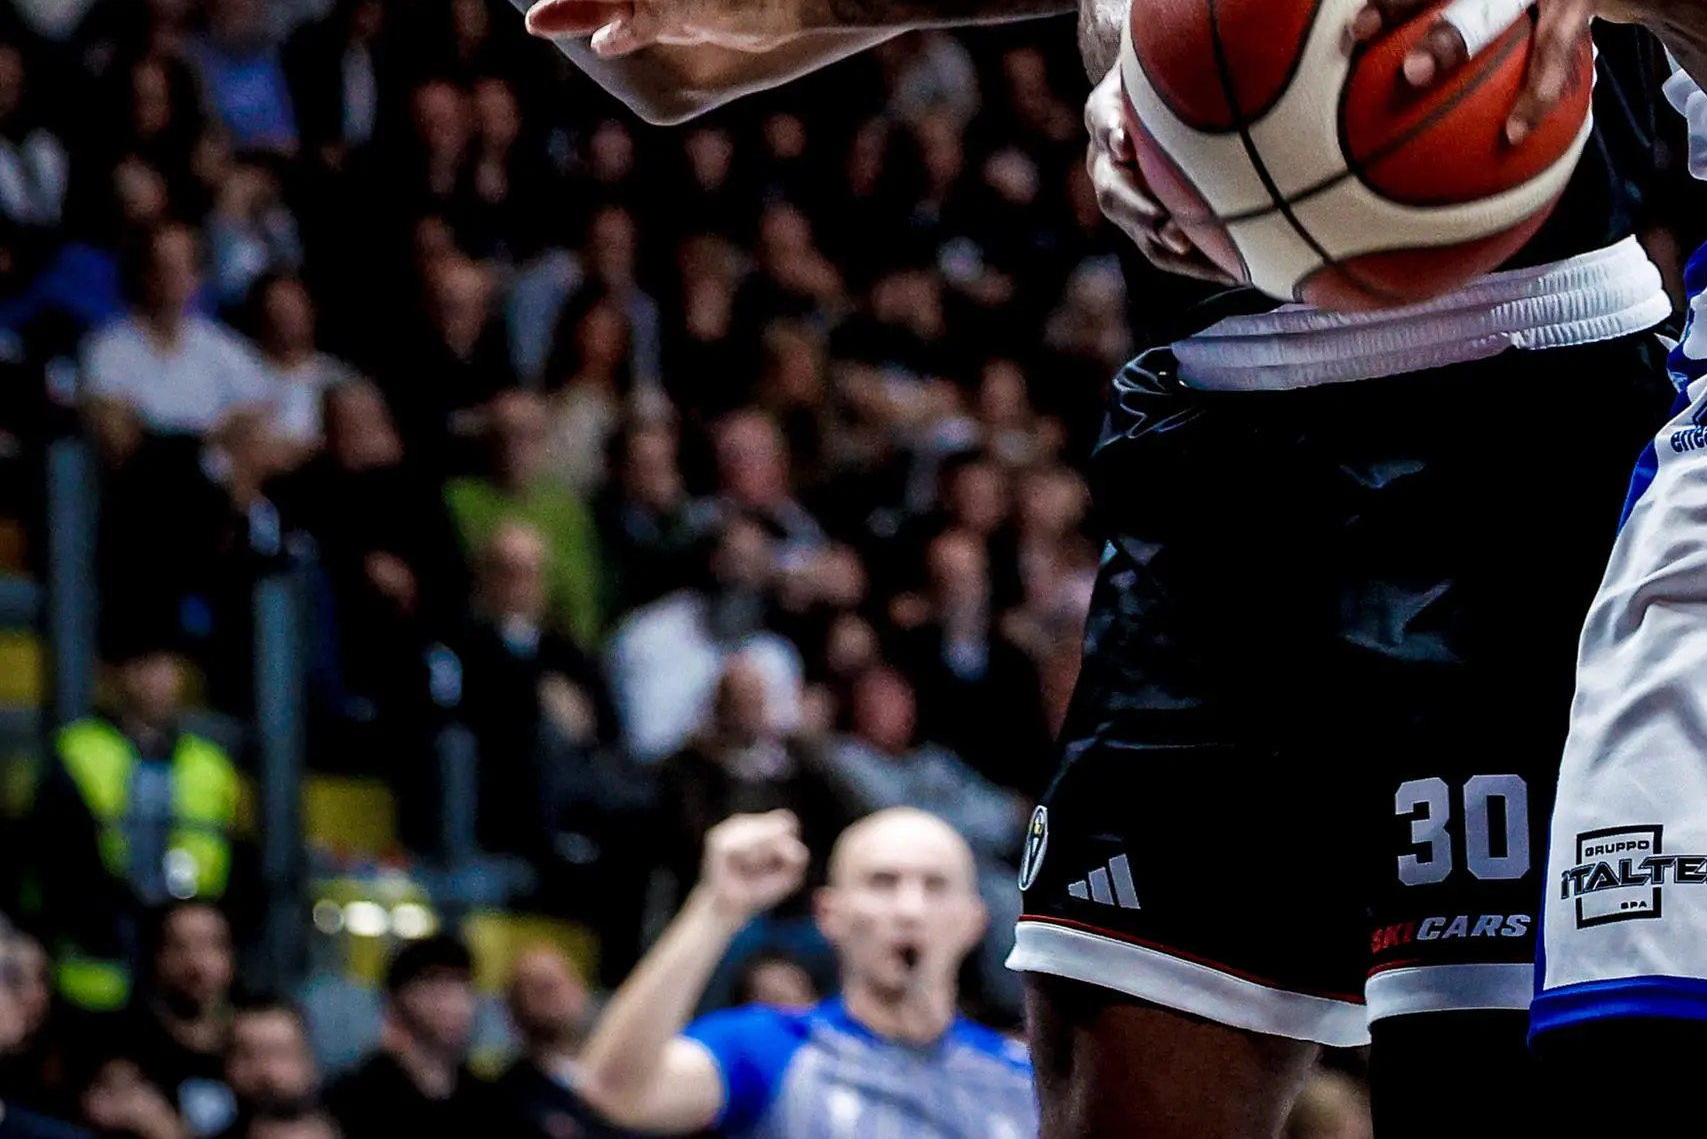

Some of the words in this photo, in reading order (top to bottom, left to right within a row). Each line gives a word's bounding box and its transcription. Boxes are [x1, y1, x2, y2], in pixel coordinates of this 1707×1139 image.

[1394, 773, 1532, 887] 30
[1584, 840, 1651, 858] GRUPPO
[1620, 899, 1649, 911] SPA
